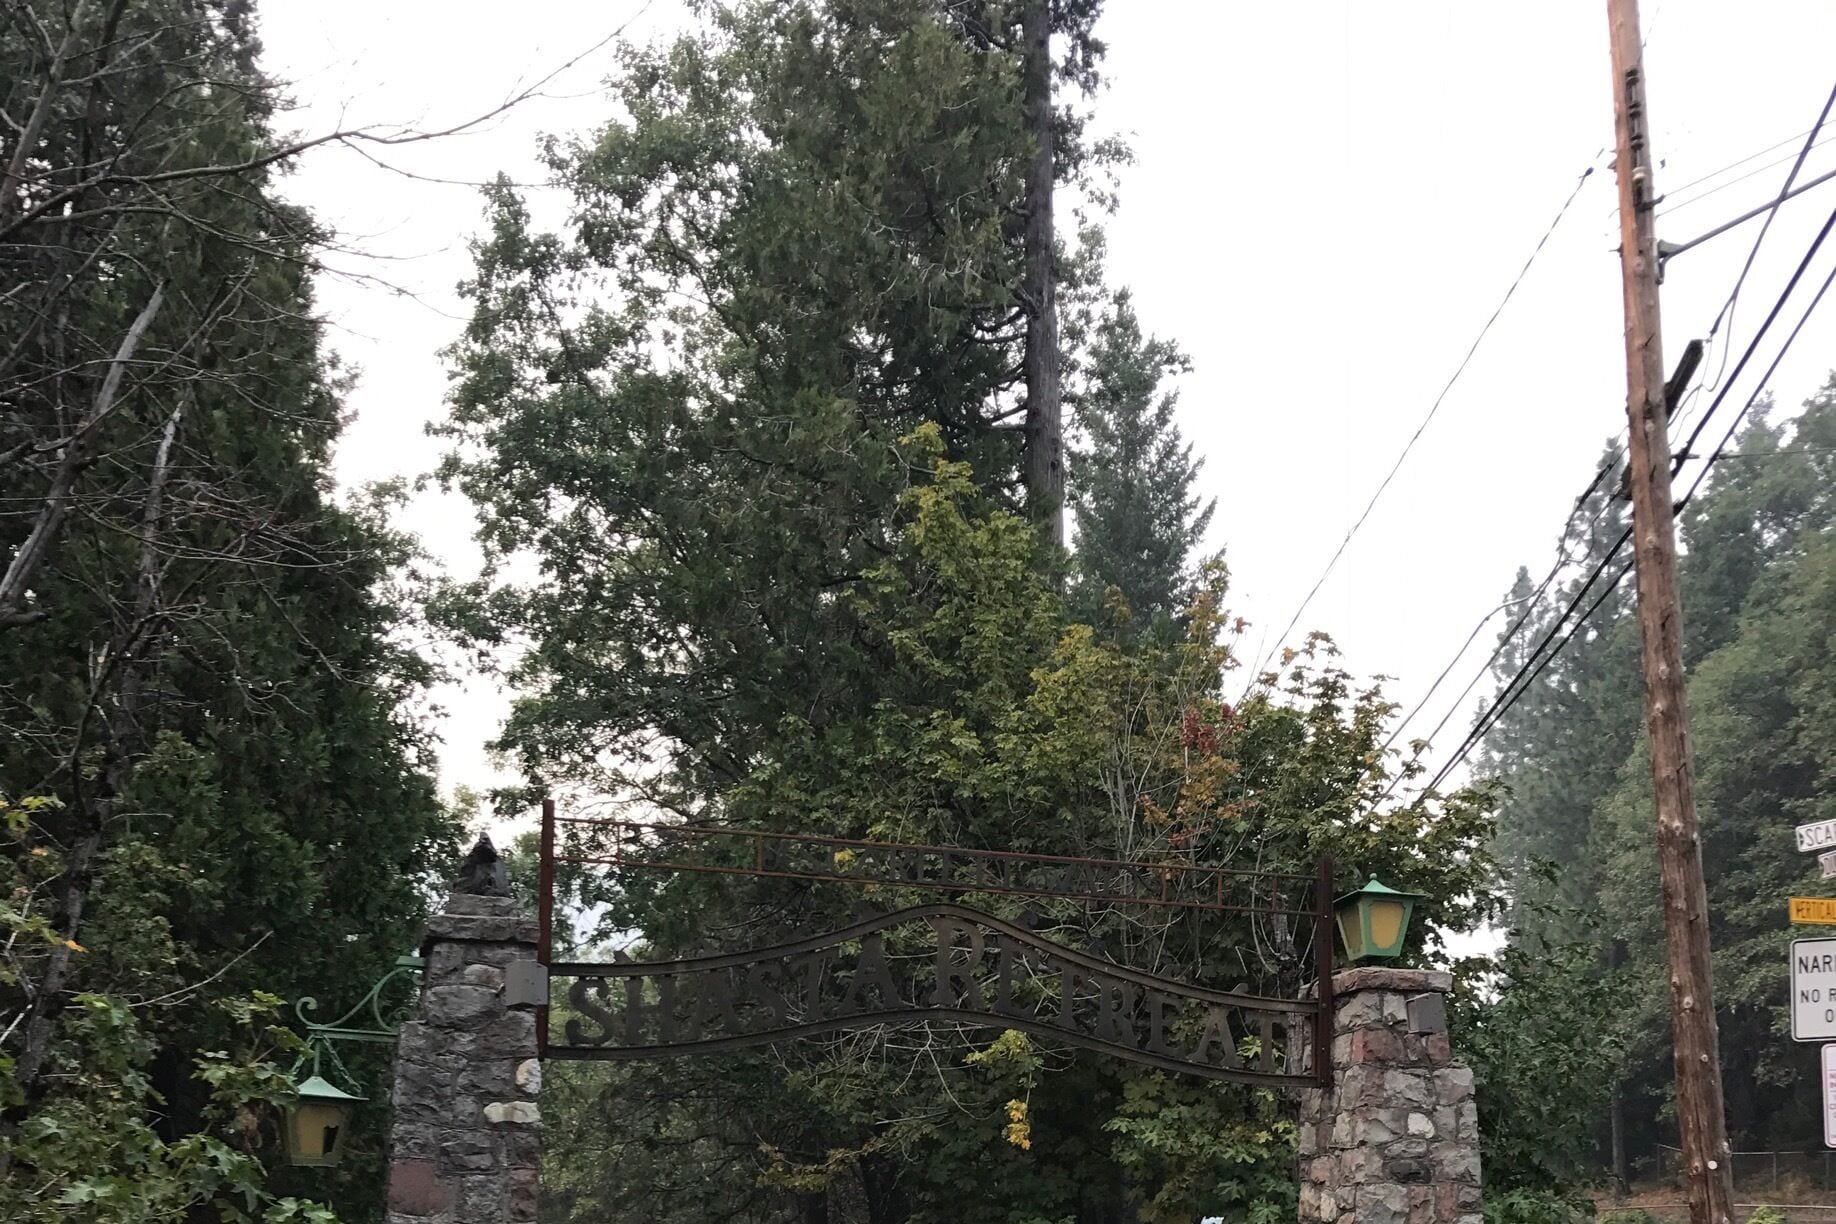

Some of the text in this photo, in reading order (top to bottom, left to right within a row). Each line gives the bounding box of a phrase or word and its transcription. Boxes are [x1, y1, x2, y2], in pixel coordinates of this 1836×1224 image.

[1798, 955, 1836, 974] NAR
[565, 914, 1296, 1073] SHASTA RETREAT
[1800, 989, 1820, 1003] NO
